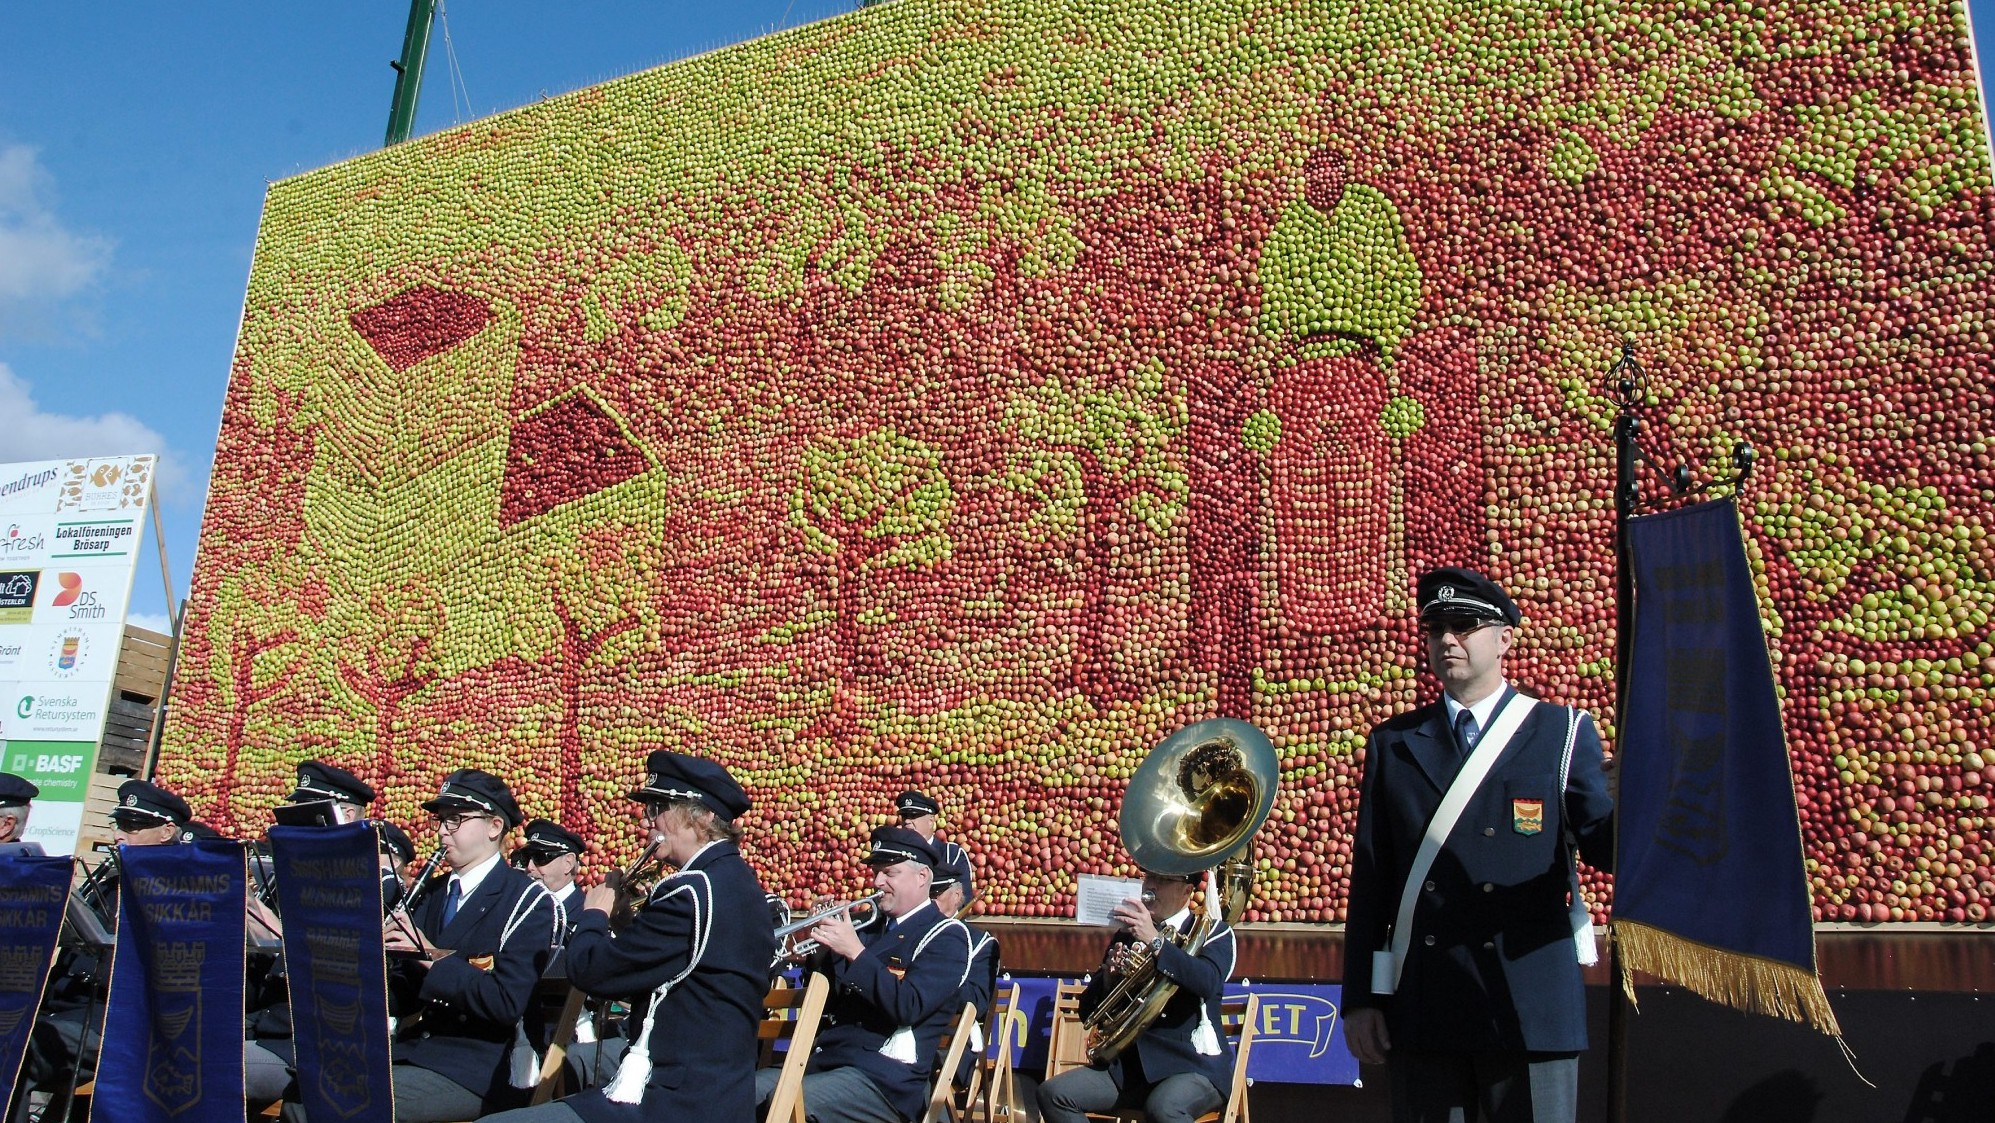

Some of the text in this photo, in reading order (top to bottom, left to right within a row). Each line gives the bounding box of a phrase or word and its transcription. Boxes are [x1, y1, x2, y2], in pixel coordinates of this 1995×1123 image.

[0, 467, 58, 496] endrups
[56, 525, 132, 538] Lokalföreningen
[73, 539, 109, 551] Brösarp
[80, 591, 97, 606] DS
[69, 603, 105, 619] Smith
[0, 645, 21, 656] rönt
[38, 695, 77, 707] Svenska
[35, 708, 96, 722] Retursystem
[35, 754, 83, 773] BASF
[43, 777, 78, 789] chemistry
[28, 825, 76, 837] CropScience
